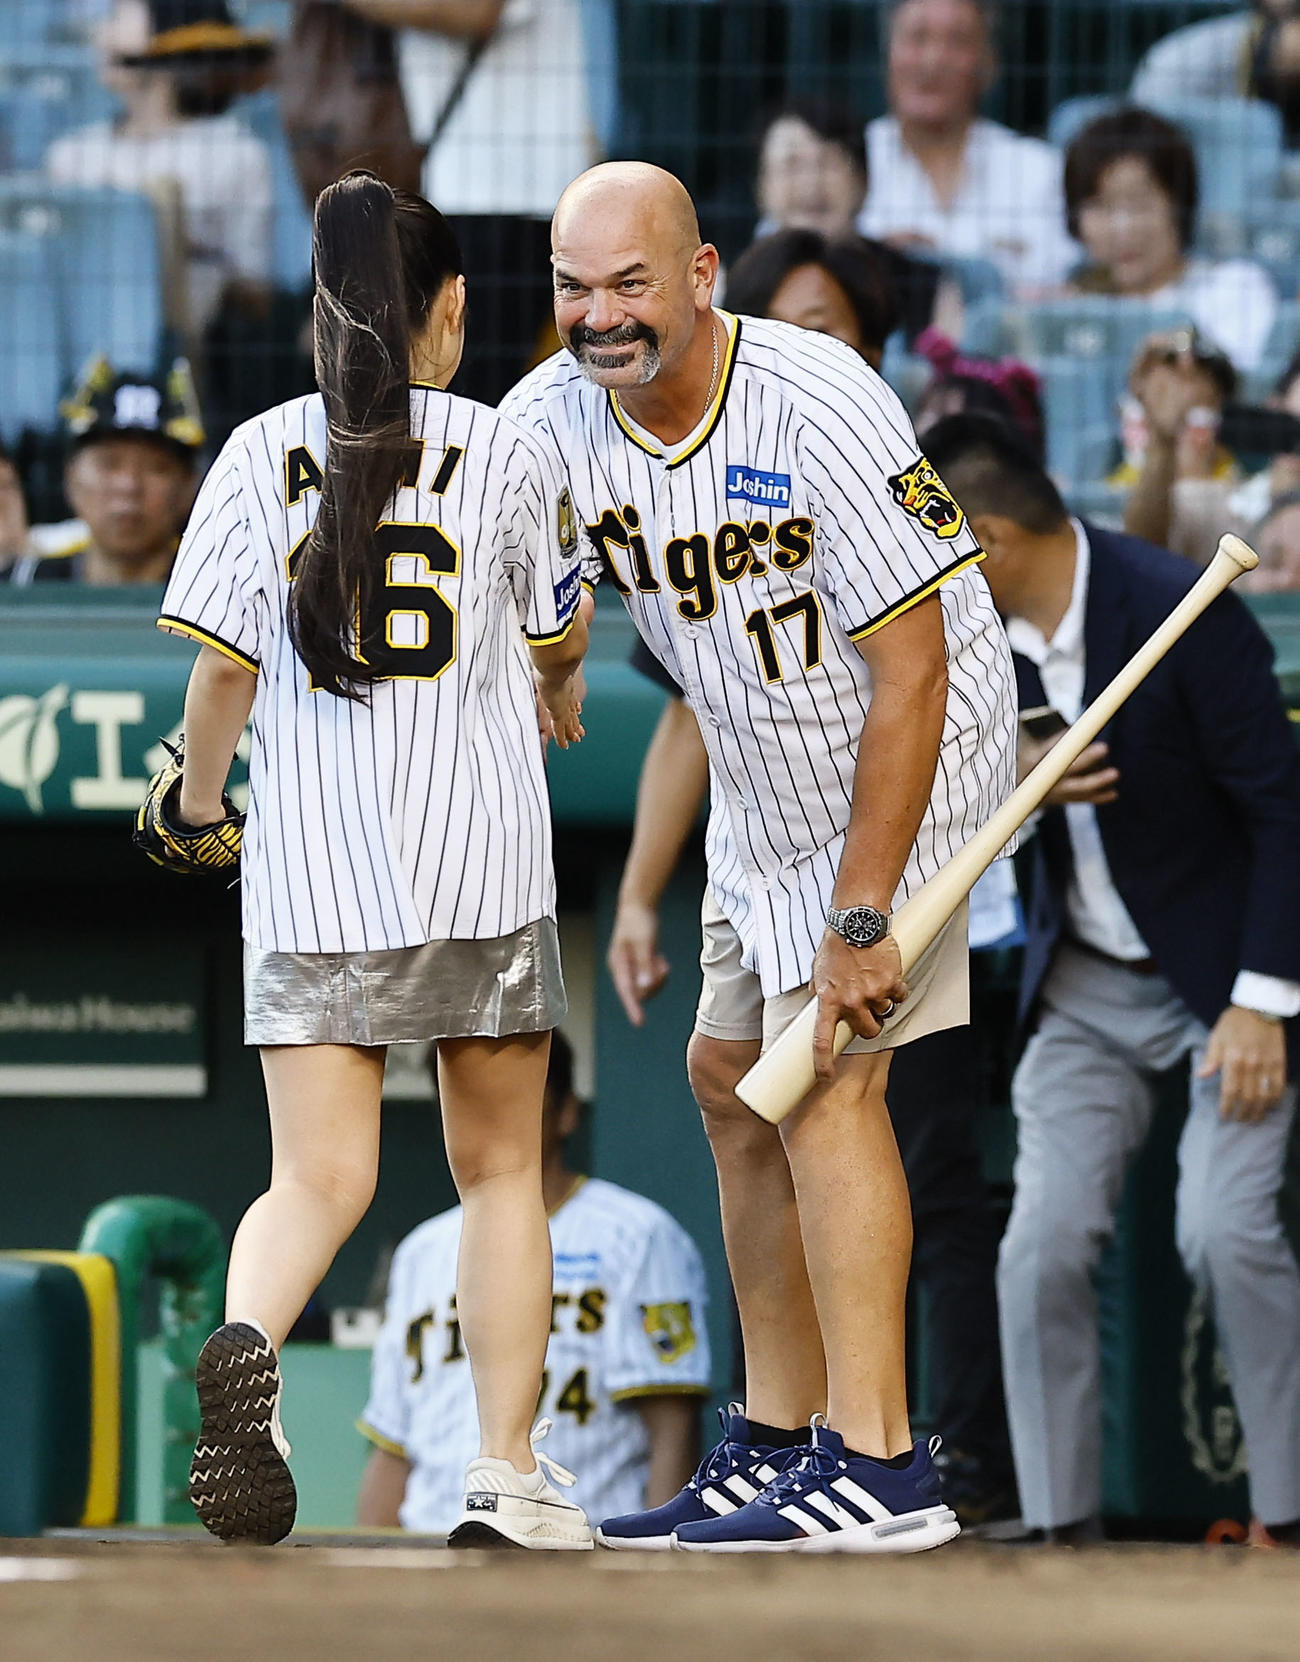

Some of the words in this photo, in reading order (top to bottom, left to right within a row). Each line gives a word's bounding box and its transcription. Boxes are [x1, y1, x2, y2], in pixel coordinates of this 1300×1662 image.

[727, 471, 789, 502] Joshin
[285, 520, 461, 693] 6
[585, 504, 815, 621] Tigers
[744, 589, 823, 685] 17
[405, 1286, 606, 1385] Tirs
